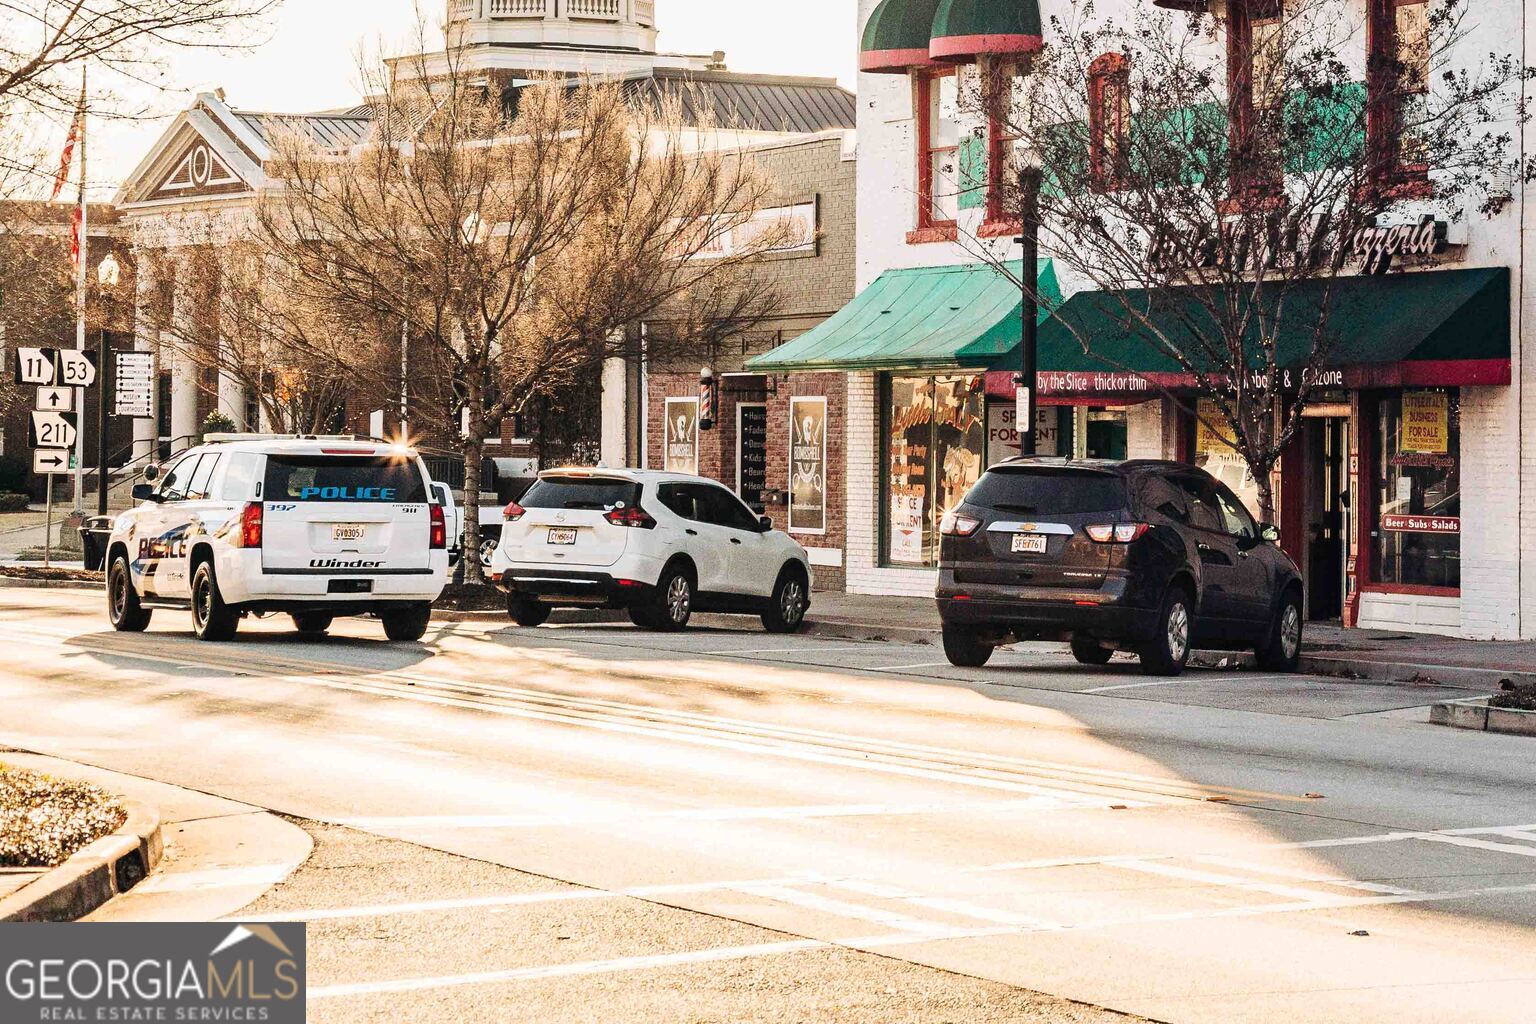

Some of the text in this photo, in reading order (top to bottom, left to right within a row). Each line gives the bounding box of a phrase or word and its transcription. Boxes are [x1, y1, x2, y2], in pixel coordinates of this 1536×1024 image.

[27, 358, 42, 378] 11
[66, 361, 87, 380] 53
[1037, 376, 1048, 393] by
[1050, 375, 1065, 391] the
[1066, 374, 1088, 391] Slice
[1094, 373, 1117, 391] thick
[1117, 378, 1126, 391] or
[1128, 375, 1147, 391] thin
[1283, 369, 1292, 388] &
[1002, 409, 1047, 423] SPE
[41, 422, 67, 444] 211
[990, 428, 1018, 441] FOR
[1408, 426, 1439, 438] FOR SALE
[301, 485, 397, 501] POLICE
[266, 504, 297, 512] 397
[1385, 518, 1458, 530] Beer Subs Salads
[309, 558, 387, 568] Winder
